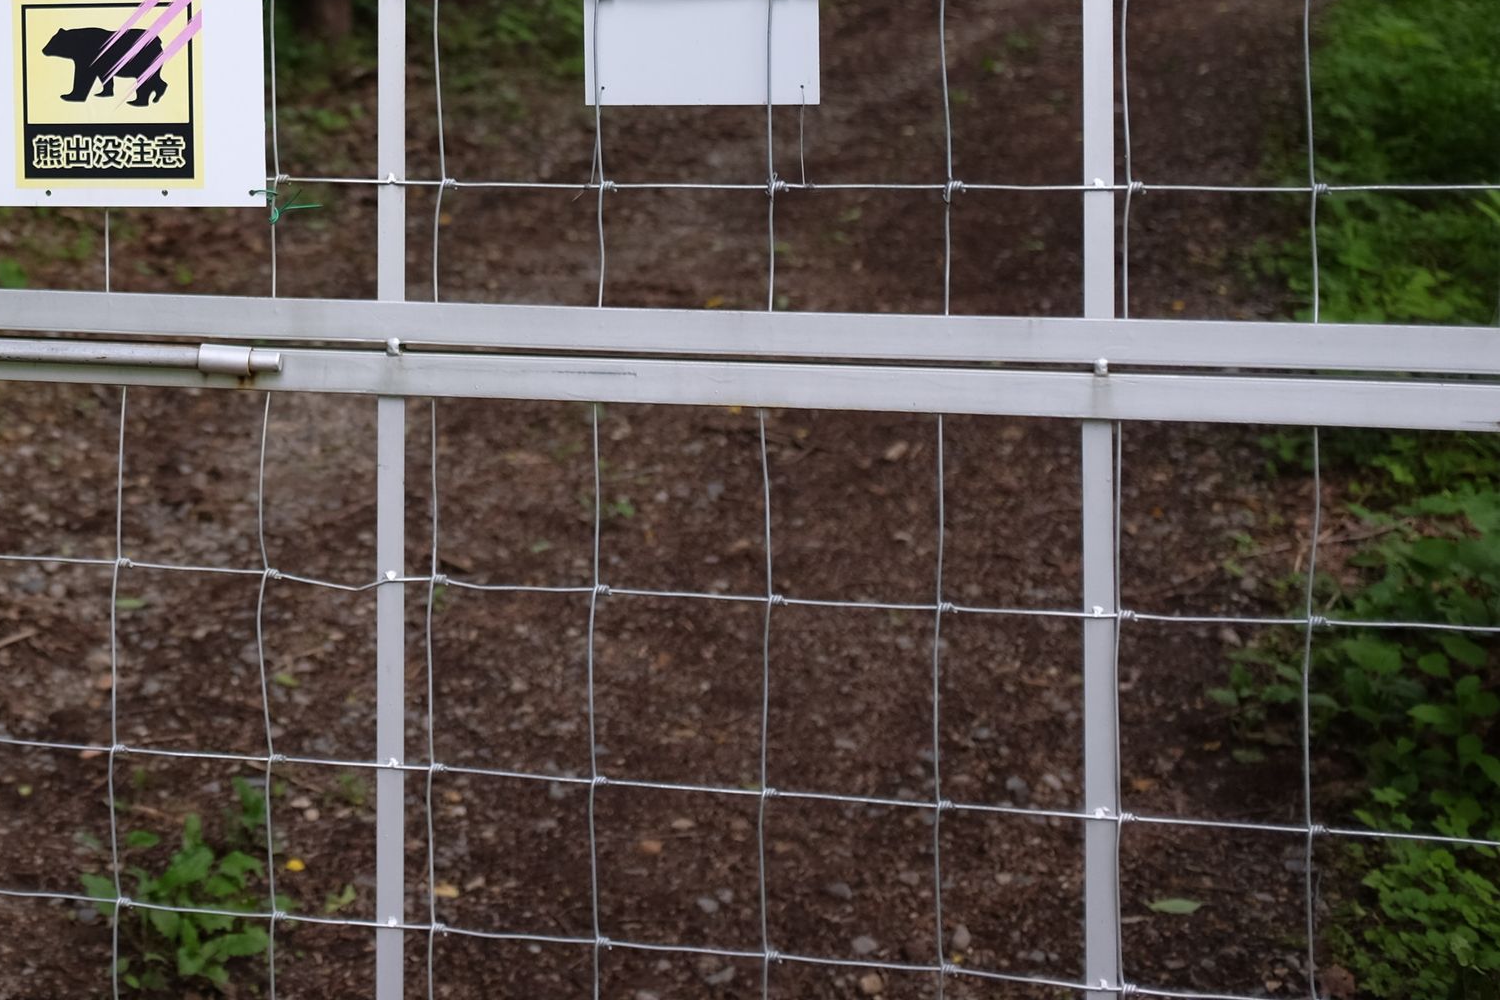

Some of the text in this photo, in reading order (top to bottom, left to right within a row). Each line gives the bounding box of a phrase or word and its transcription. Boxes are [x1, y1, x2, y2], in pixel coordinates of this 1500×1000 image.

[33, 133, 188, 170] 熊出没注意
